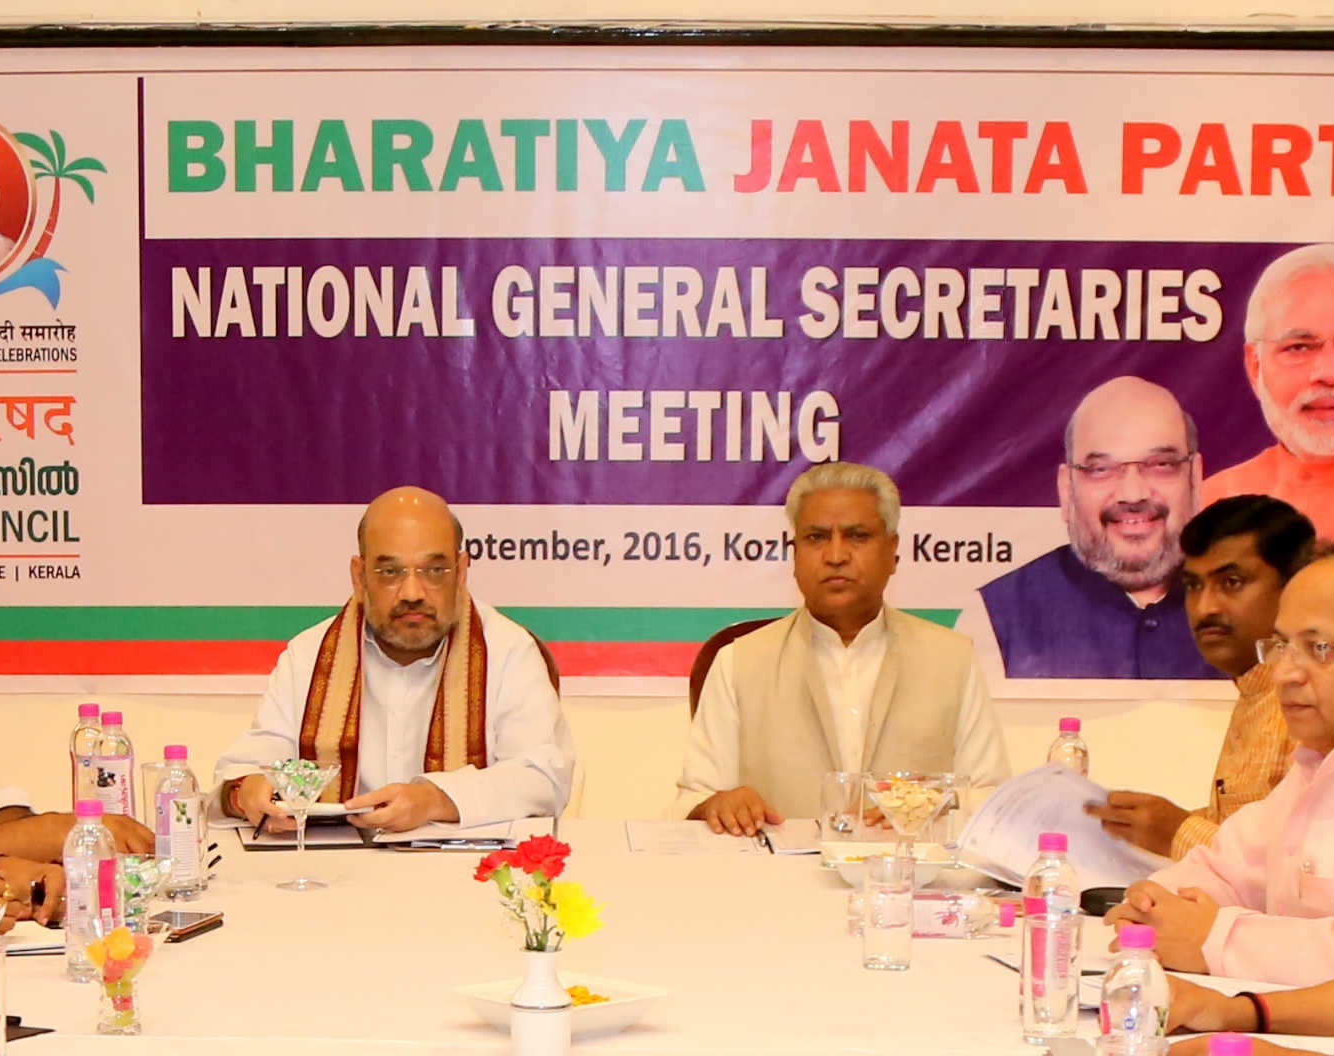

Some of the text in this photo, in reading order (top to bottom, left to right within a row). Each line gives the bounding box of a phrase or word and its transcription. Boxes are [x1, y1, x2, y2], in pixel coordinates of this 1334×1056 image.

[167, 119, 706, 192] BHARATIYA
[734, 119, 1089, 195] JANATA
[19, 317, 77, 344] समारोह
[171, 265, 1222, 342] NATIONAL GENERAL SECRETARIES
[549, 390, 840, 463] MEETING
[28, 564, 81, 580] KERALA
[465, 530, 612, 567] ptember,
[623, 531, 712, 567] 2016,
[912, 532, 1013, 563] Kerala
